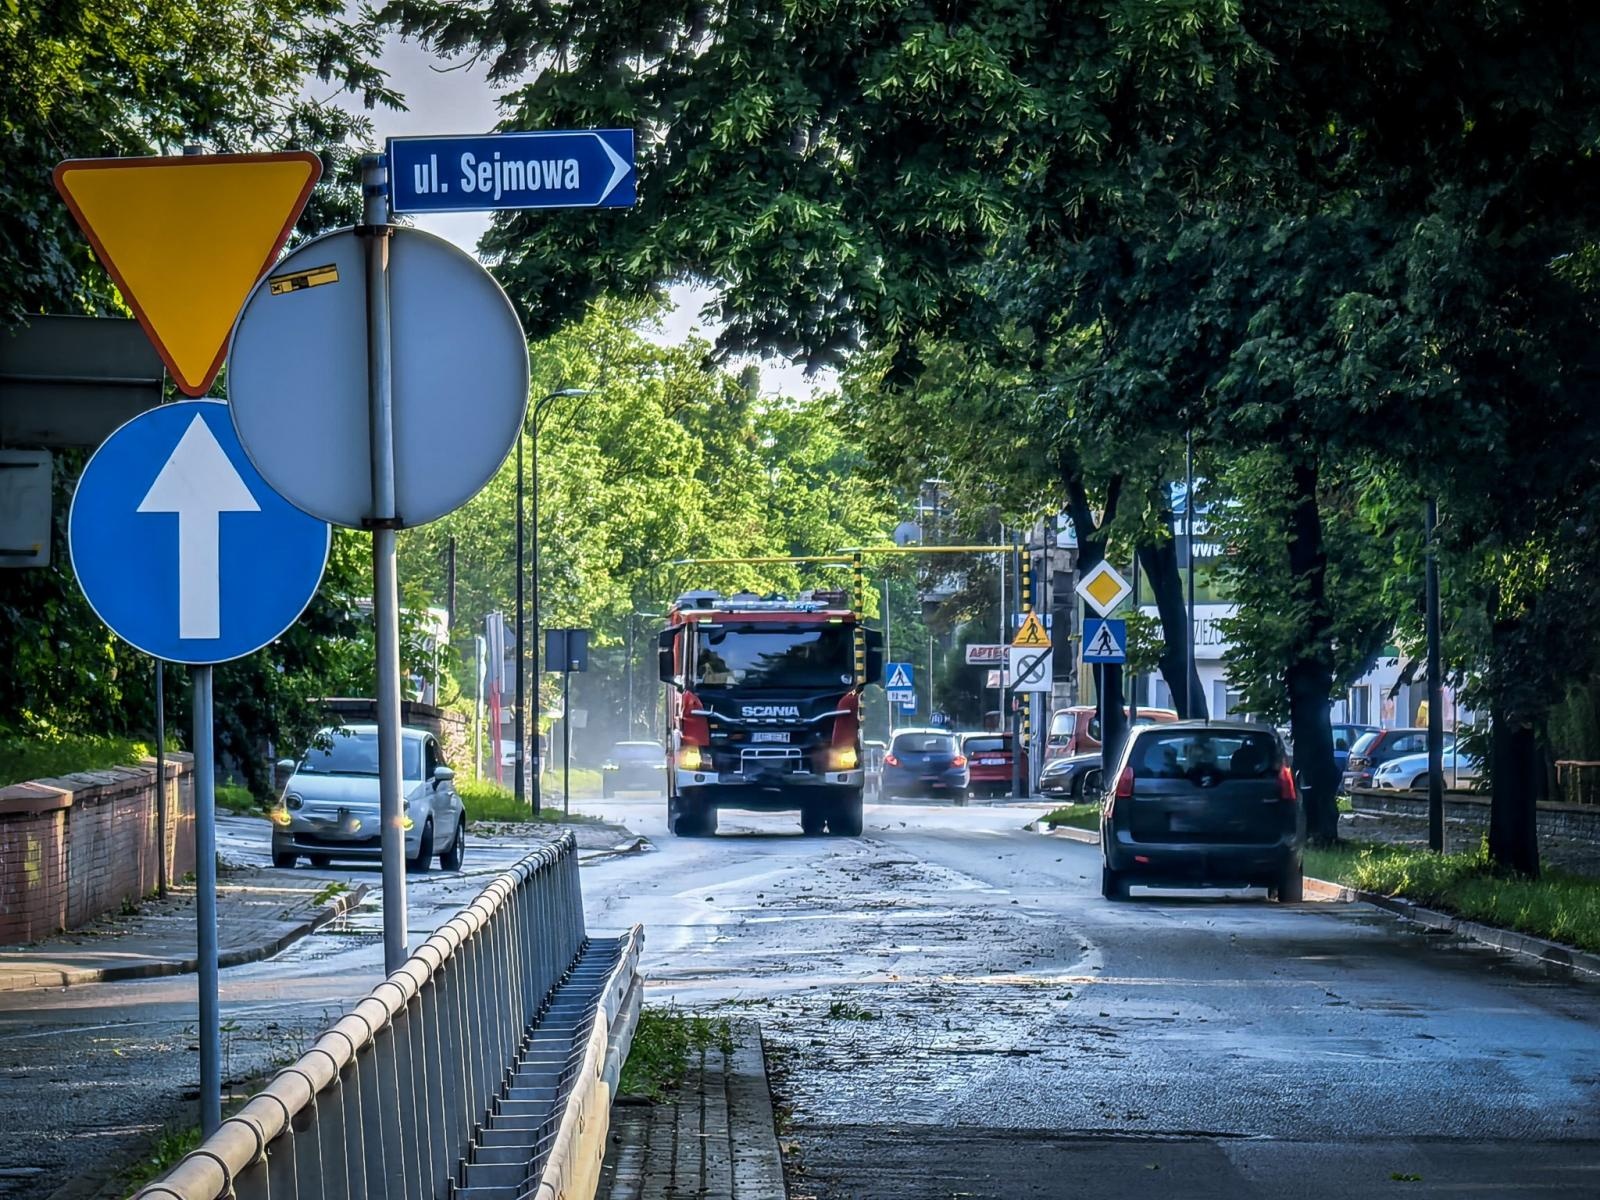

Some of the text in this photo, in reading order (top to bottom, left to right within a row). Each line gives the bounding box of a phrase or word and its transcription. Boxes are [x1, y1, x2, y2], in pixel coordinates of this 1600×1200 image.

[414, 151, 580, 201] ul. Sejmowa
[741, 705, 800, 717] SCANIA
